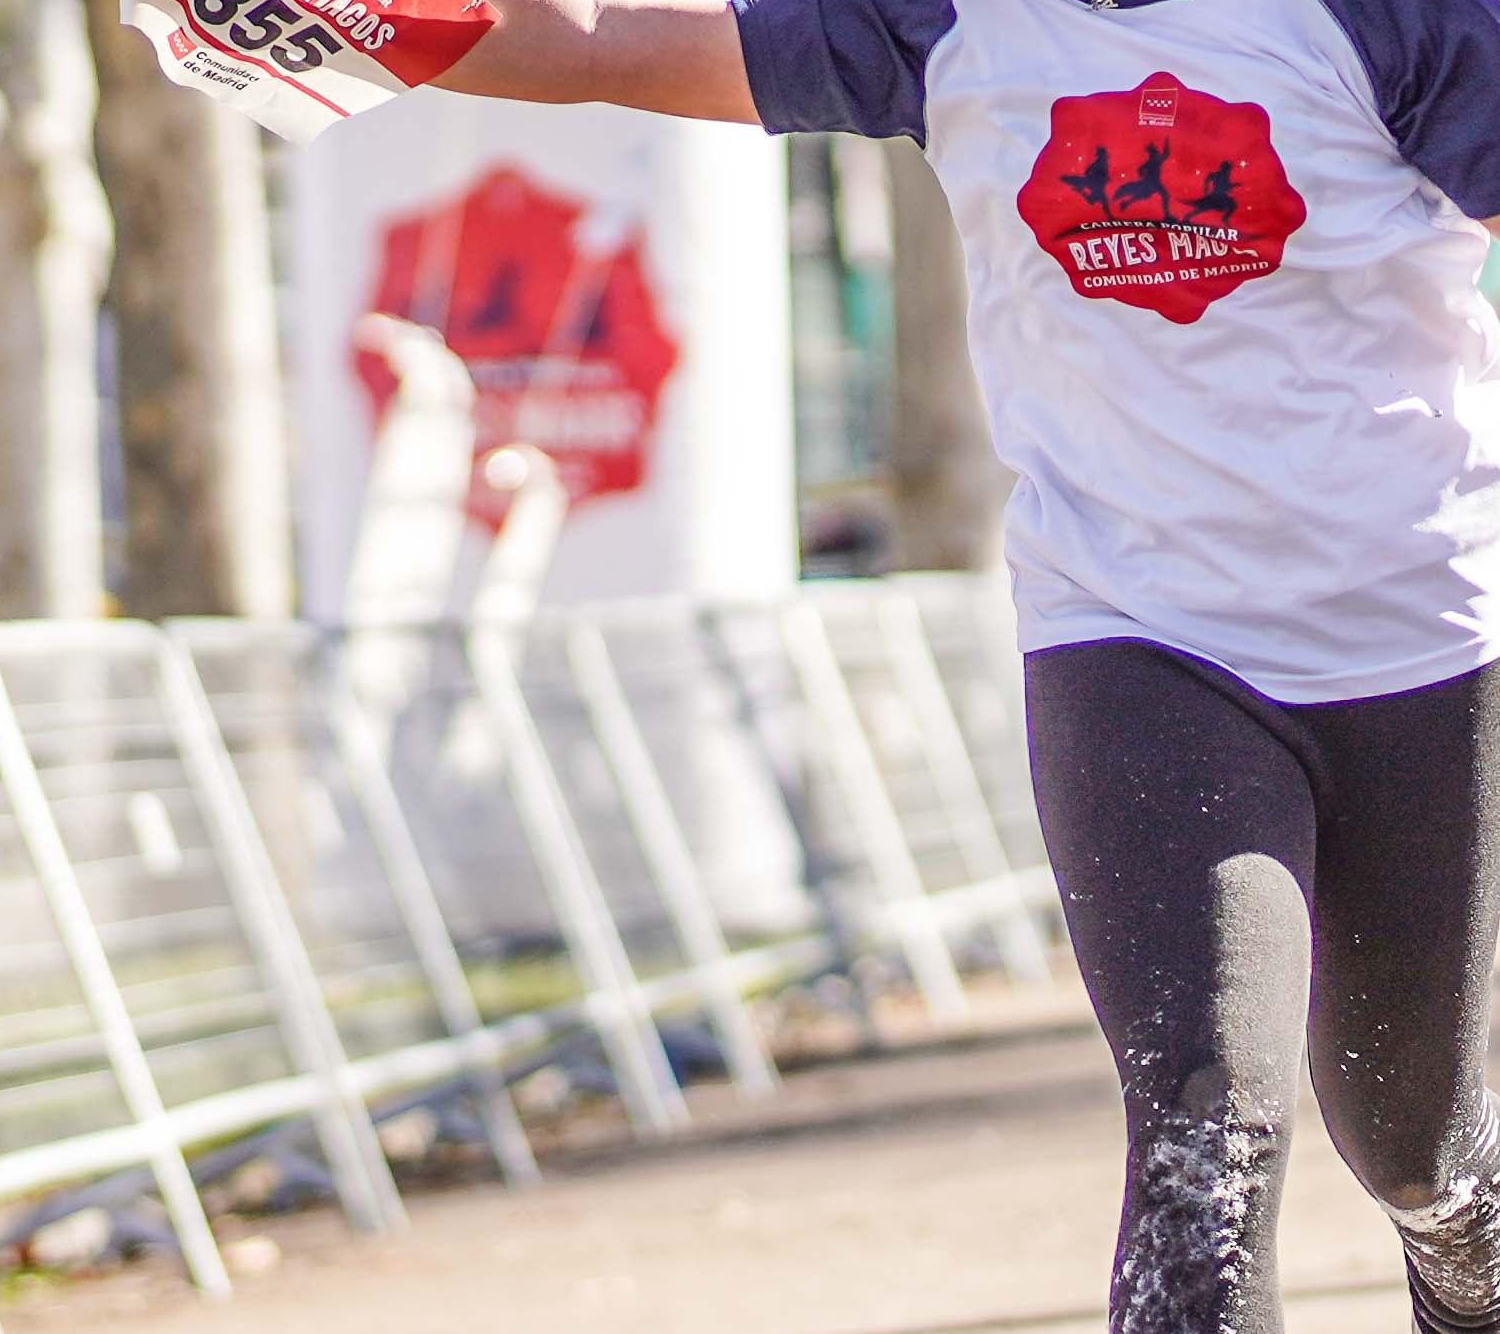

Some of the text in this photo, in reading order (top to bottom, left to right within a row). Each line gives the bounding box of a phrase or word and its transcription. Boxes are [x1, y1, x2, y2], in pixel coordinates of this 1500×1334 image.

[183, 60, 248, 90] de Madrid
[196, 51, 260, 82] Comunidad
[1068, 232, 1157, 271] REYES
[1083, 261, 1269, 288] COMUNIDAD DE MADRID
